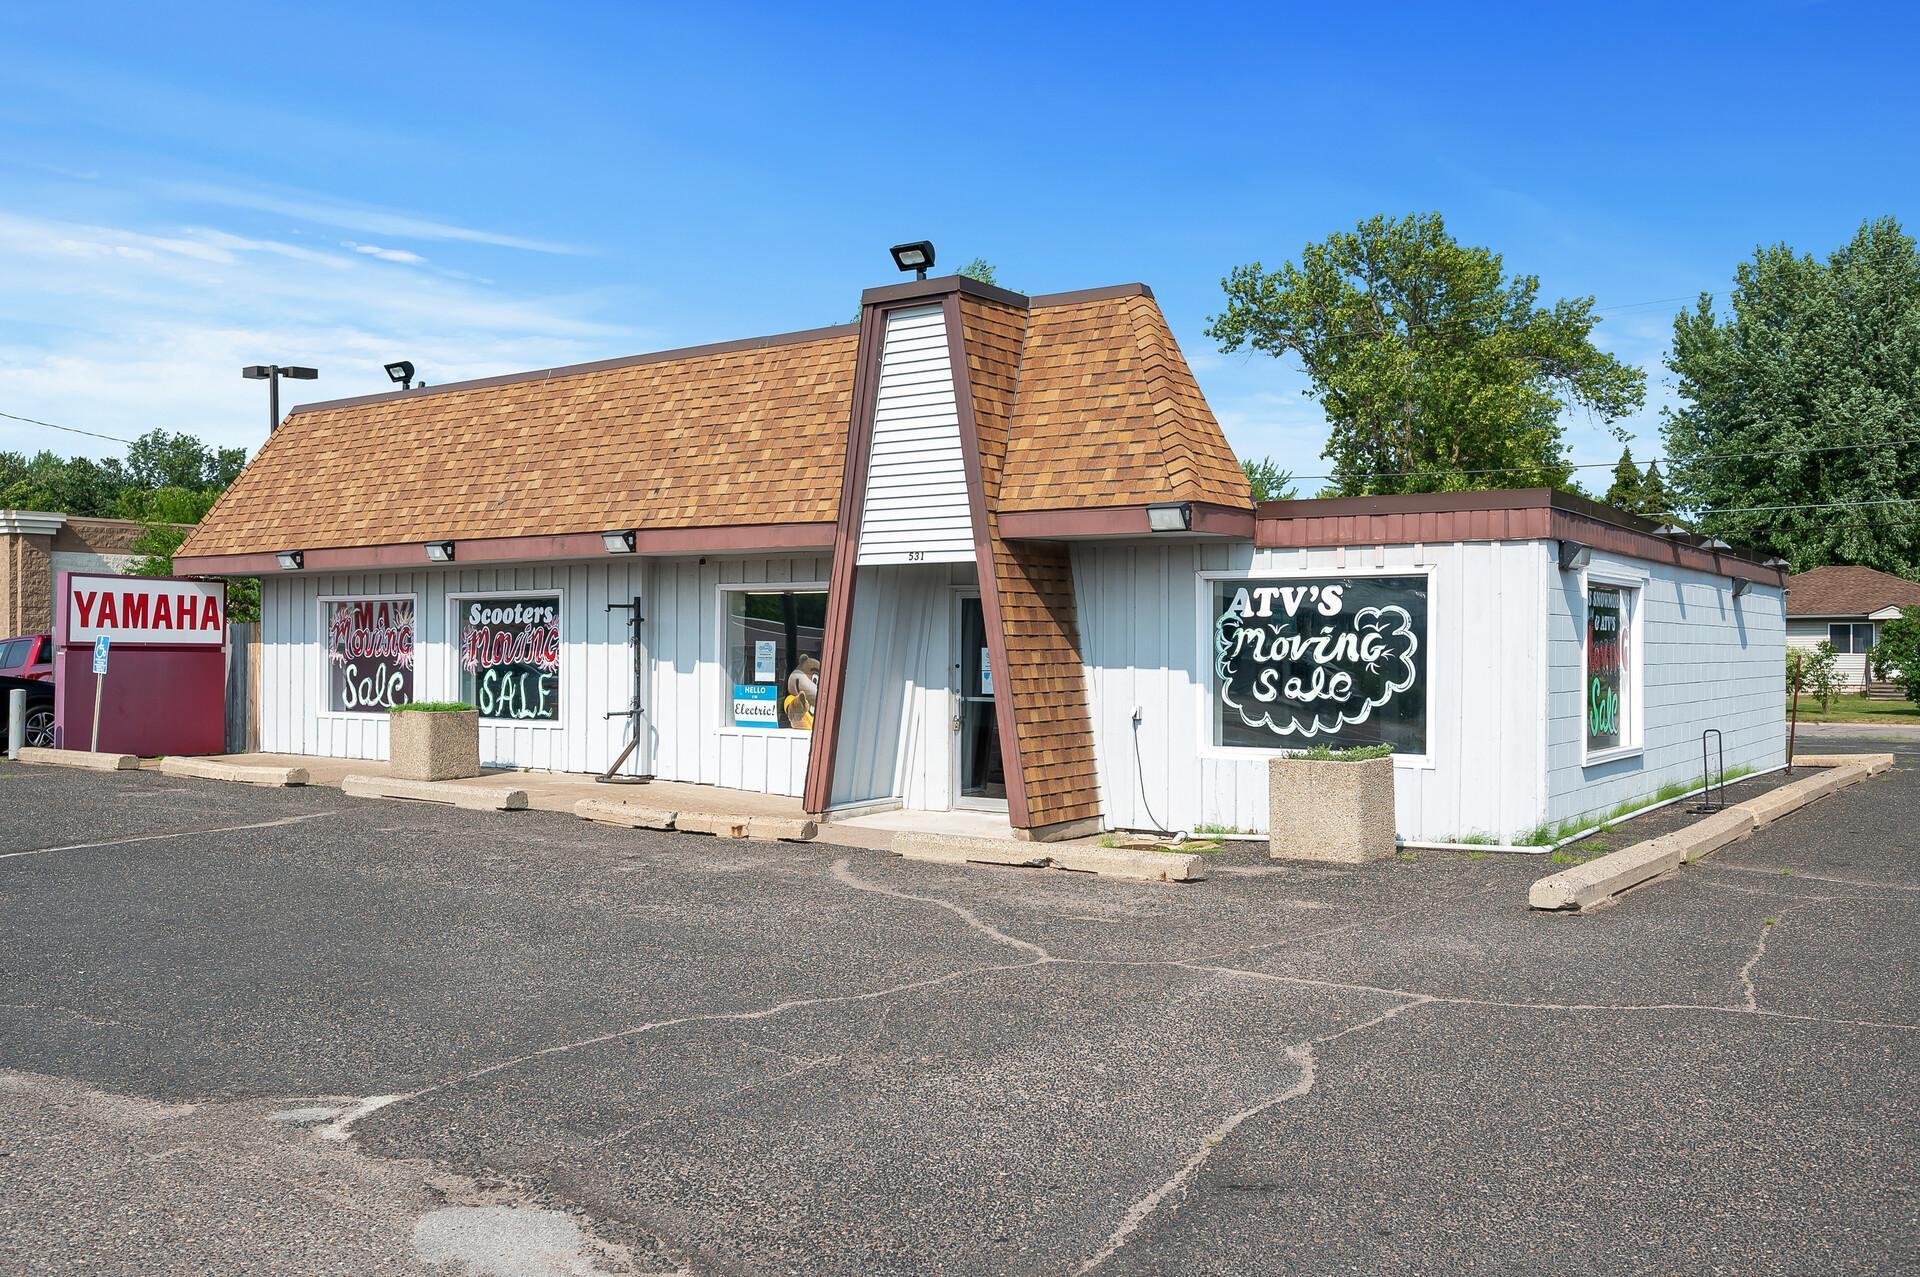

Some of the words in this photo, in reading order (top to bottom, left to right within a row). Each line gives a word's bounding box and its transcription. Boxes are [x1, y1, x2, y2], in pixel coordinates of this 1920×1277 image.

[908, 551, 925, 561] 531
[73, 590, 221, 631] YAMAHA
[469, 603, 553, 625] Scooters
[1225, 584, 1344, 618] ATV'S
[342, 662, 407, 709] Sale
[479, 668, 553, 719] SALE
[744, 686, 766, 694] HELLO
[1252, 666, 1353, 702] Sale
[734, 703, 776, 716] Electric!
[1589, 676, 1619, 737] Sale
